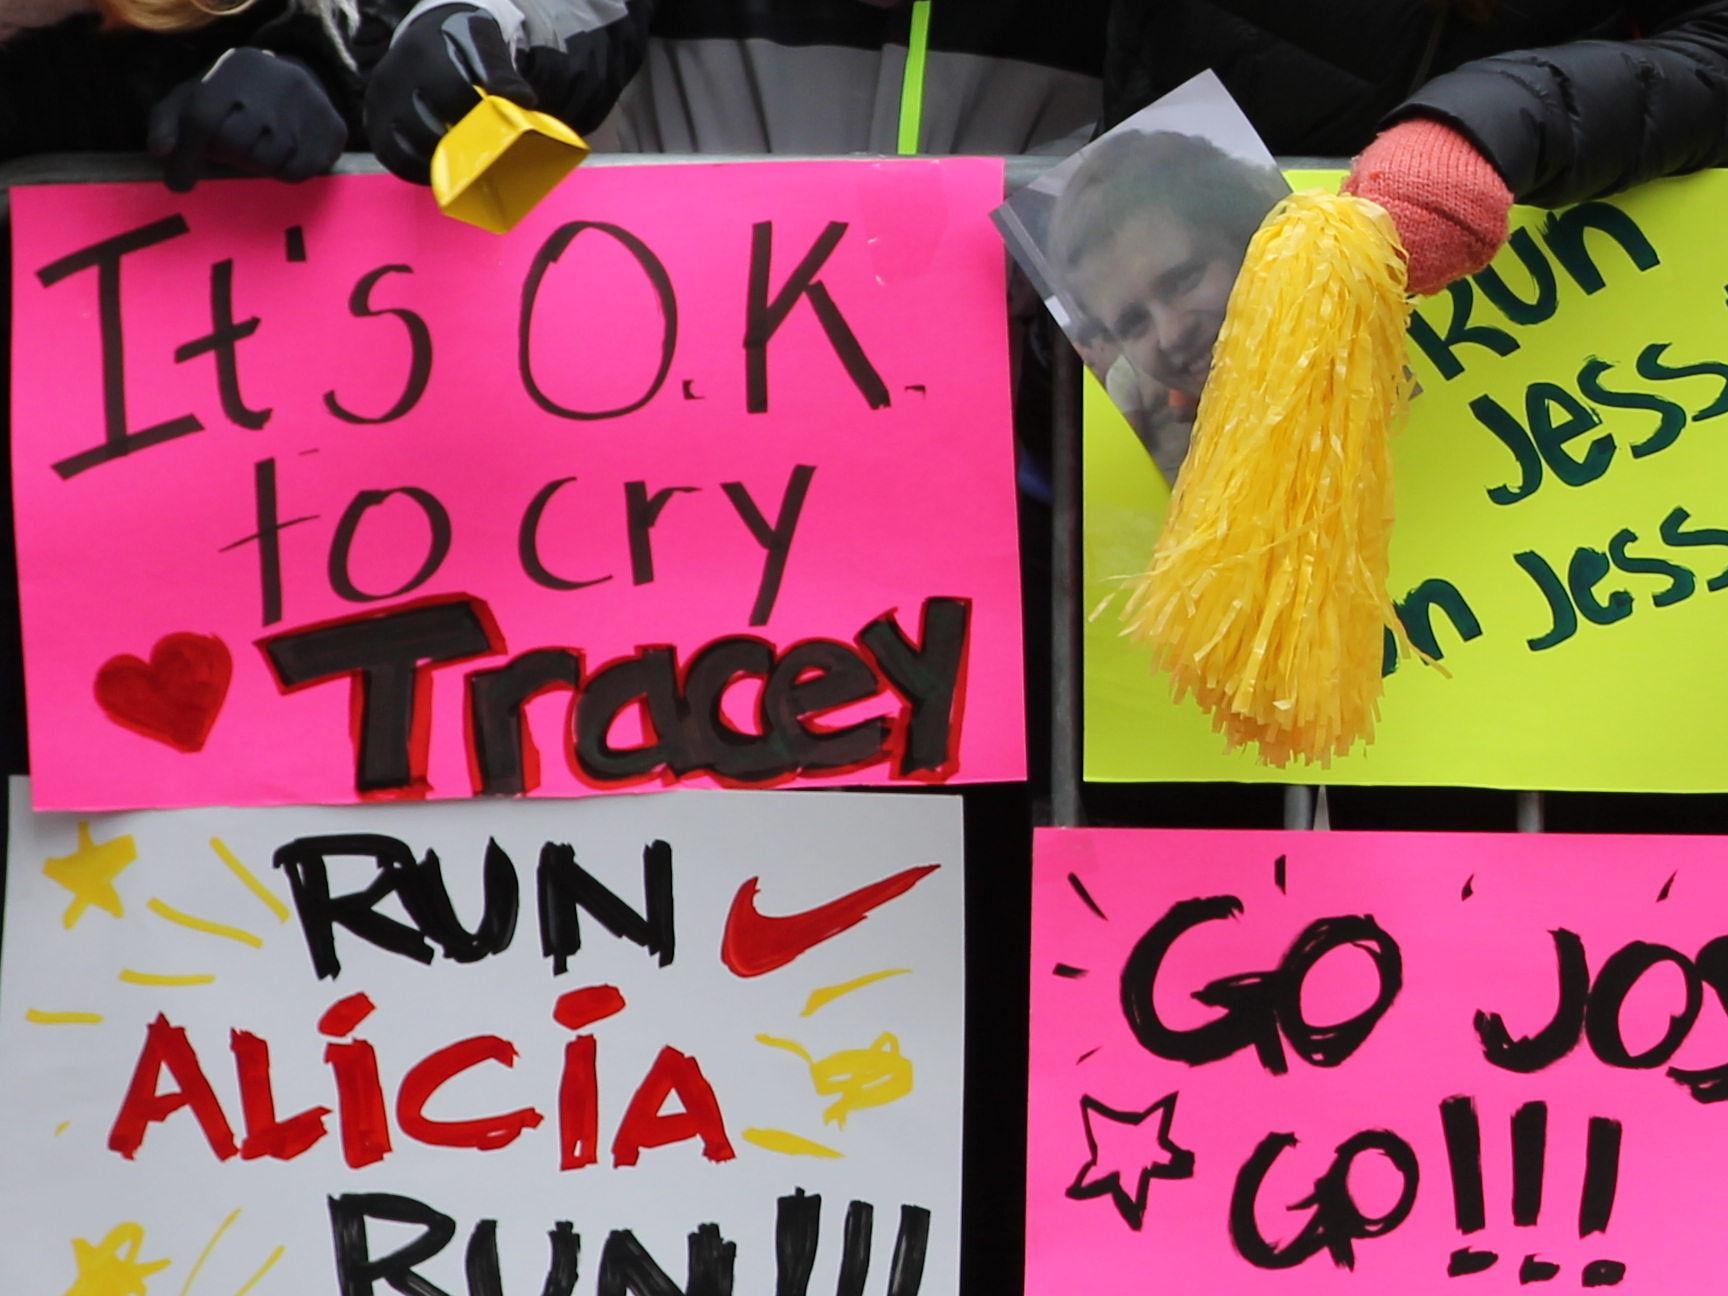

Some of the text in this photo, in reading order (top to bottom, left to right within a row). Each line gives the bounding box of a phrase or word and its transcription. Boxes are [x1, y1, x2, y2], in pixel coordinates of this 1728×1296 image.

[34, 213, 434, 482] It's
[219, 457, 818, 627] to cry
[256, 592, 973, 796] Tracey
[274, 833, 673, 979] RUN
[1119, 893, 1403, 1076] GO
[1227, 1095, 1626, 1289] GO!!!
